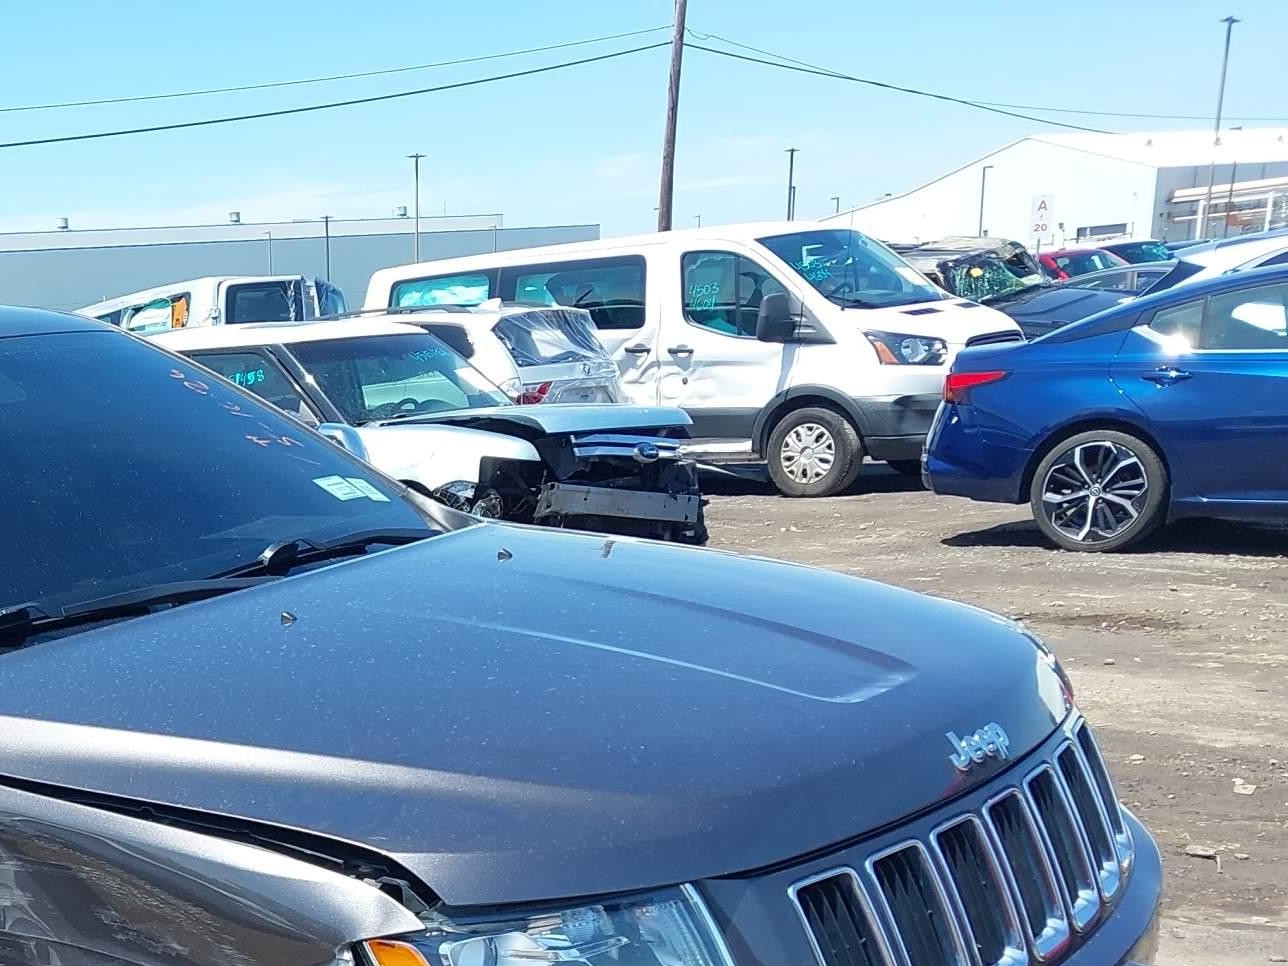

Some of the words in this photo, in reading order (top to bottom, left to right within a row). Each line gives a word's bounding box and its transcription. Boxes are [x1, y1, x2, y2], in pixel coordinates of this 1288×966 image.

[1037, 200, 1048, 212] A
[1033, 223, 1048, 232] 20
[944, 722, 1010, 772] Jeep
